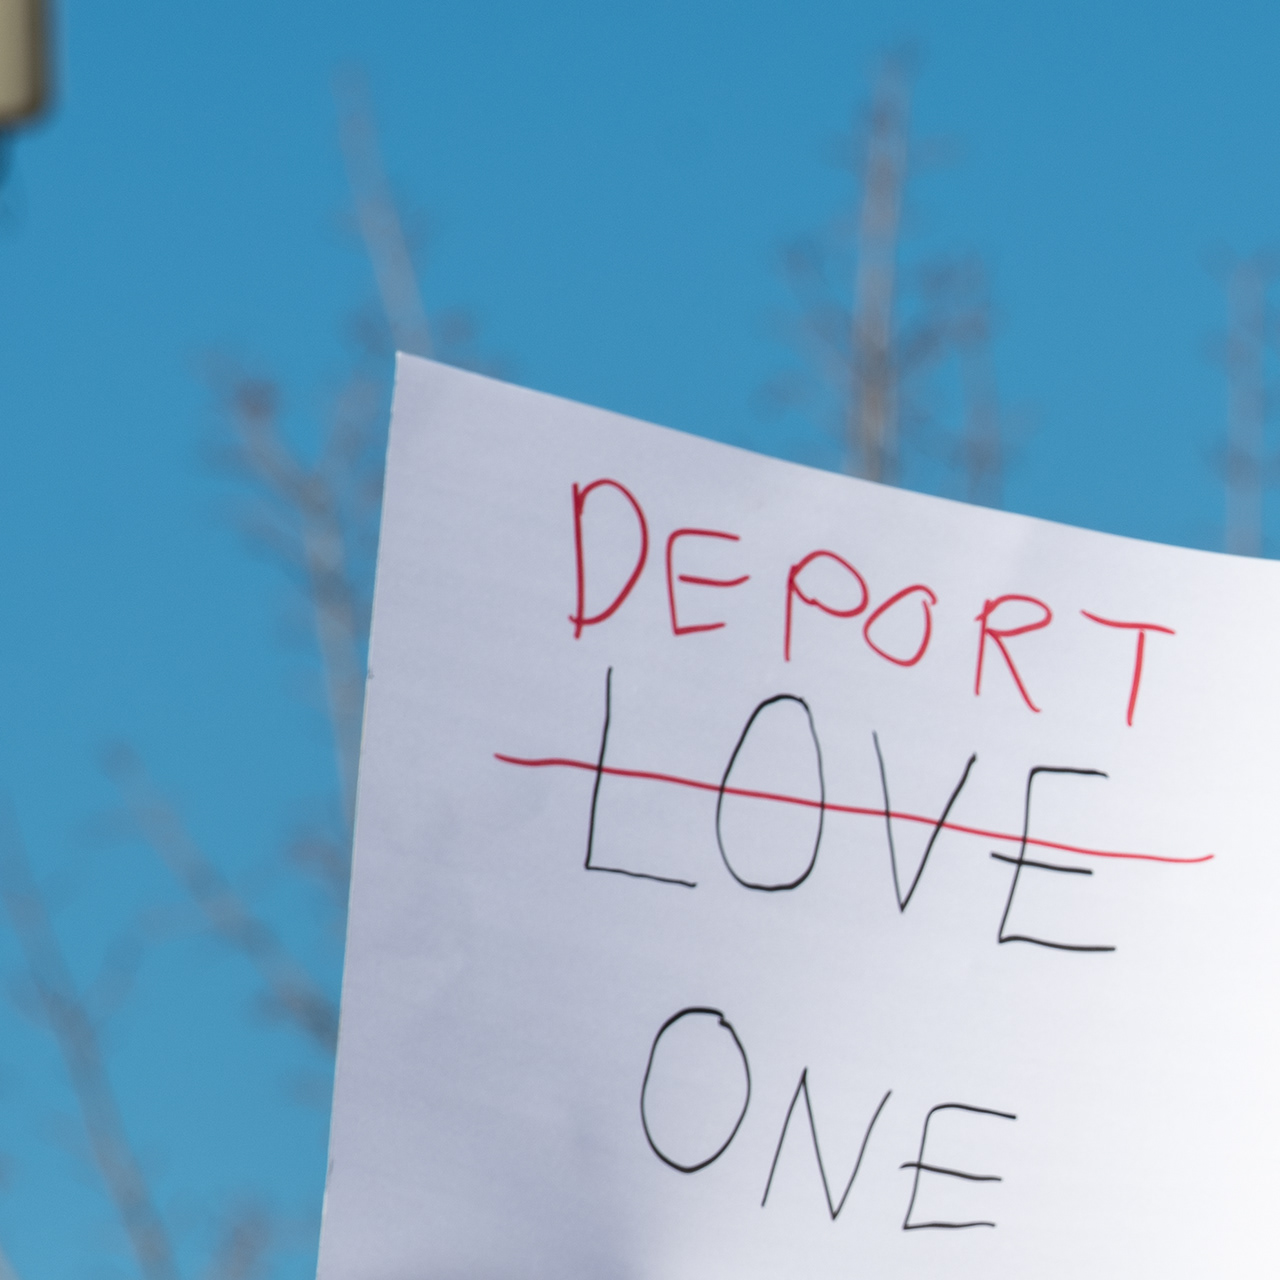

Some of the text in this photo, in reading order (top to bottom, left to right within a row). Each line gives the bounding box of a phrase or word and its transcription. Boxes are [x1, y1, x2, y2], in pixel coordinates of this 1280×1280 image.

[569, 478, 1176, 726] DEPORT
[585, 667, 1117, 952] LOVE
[640, 1006, 1017, 1231] ONE
